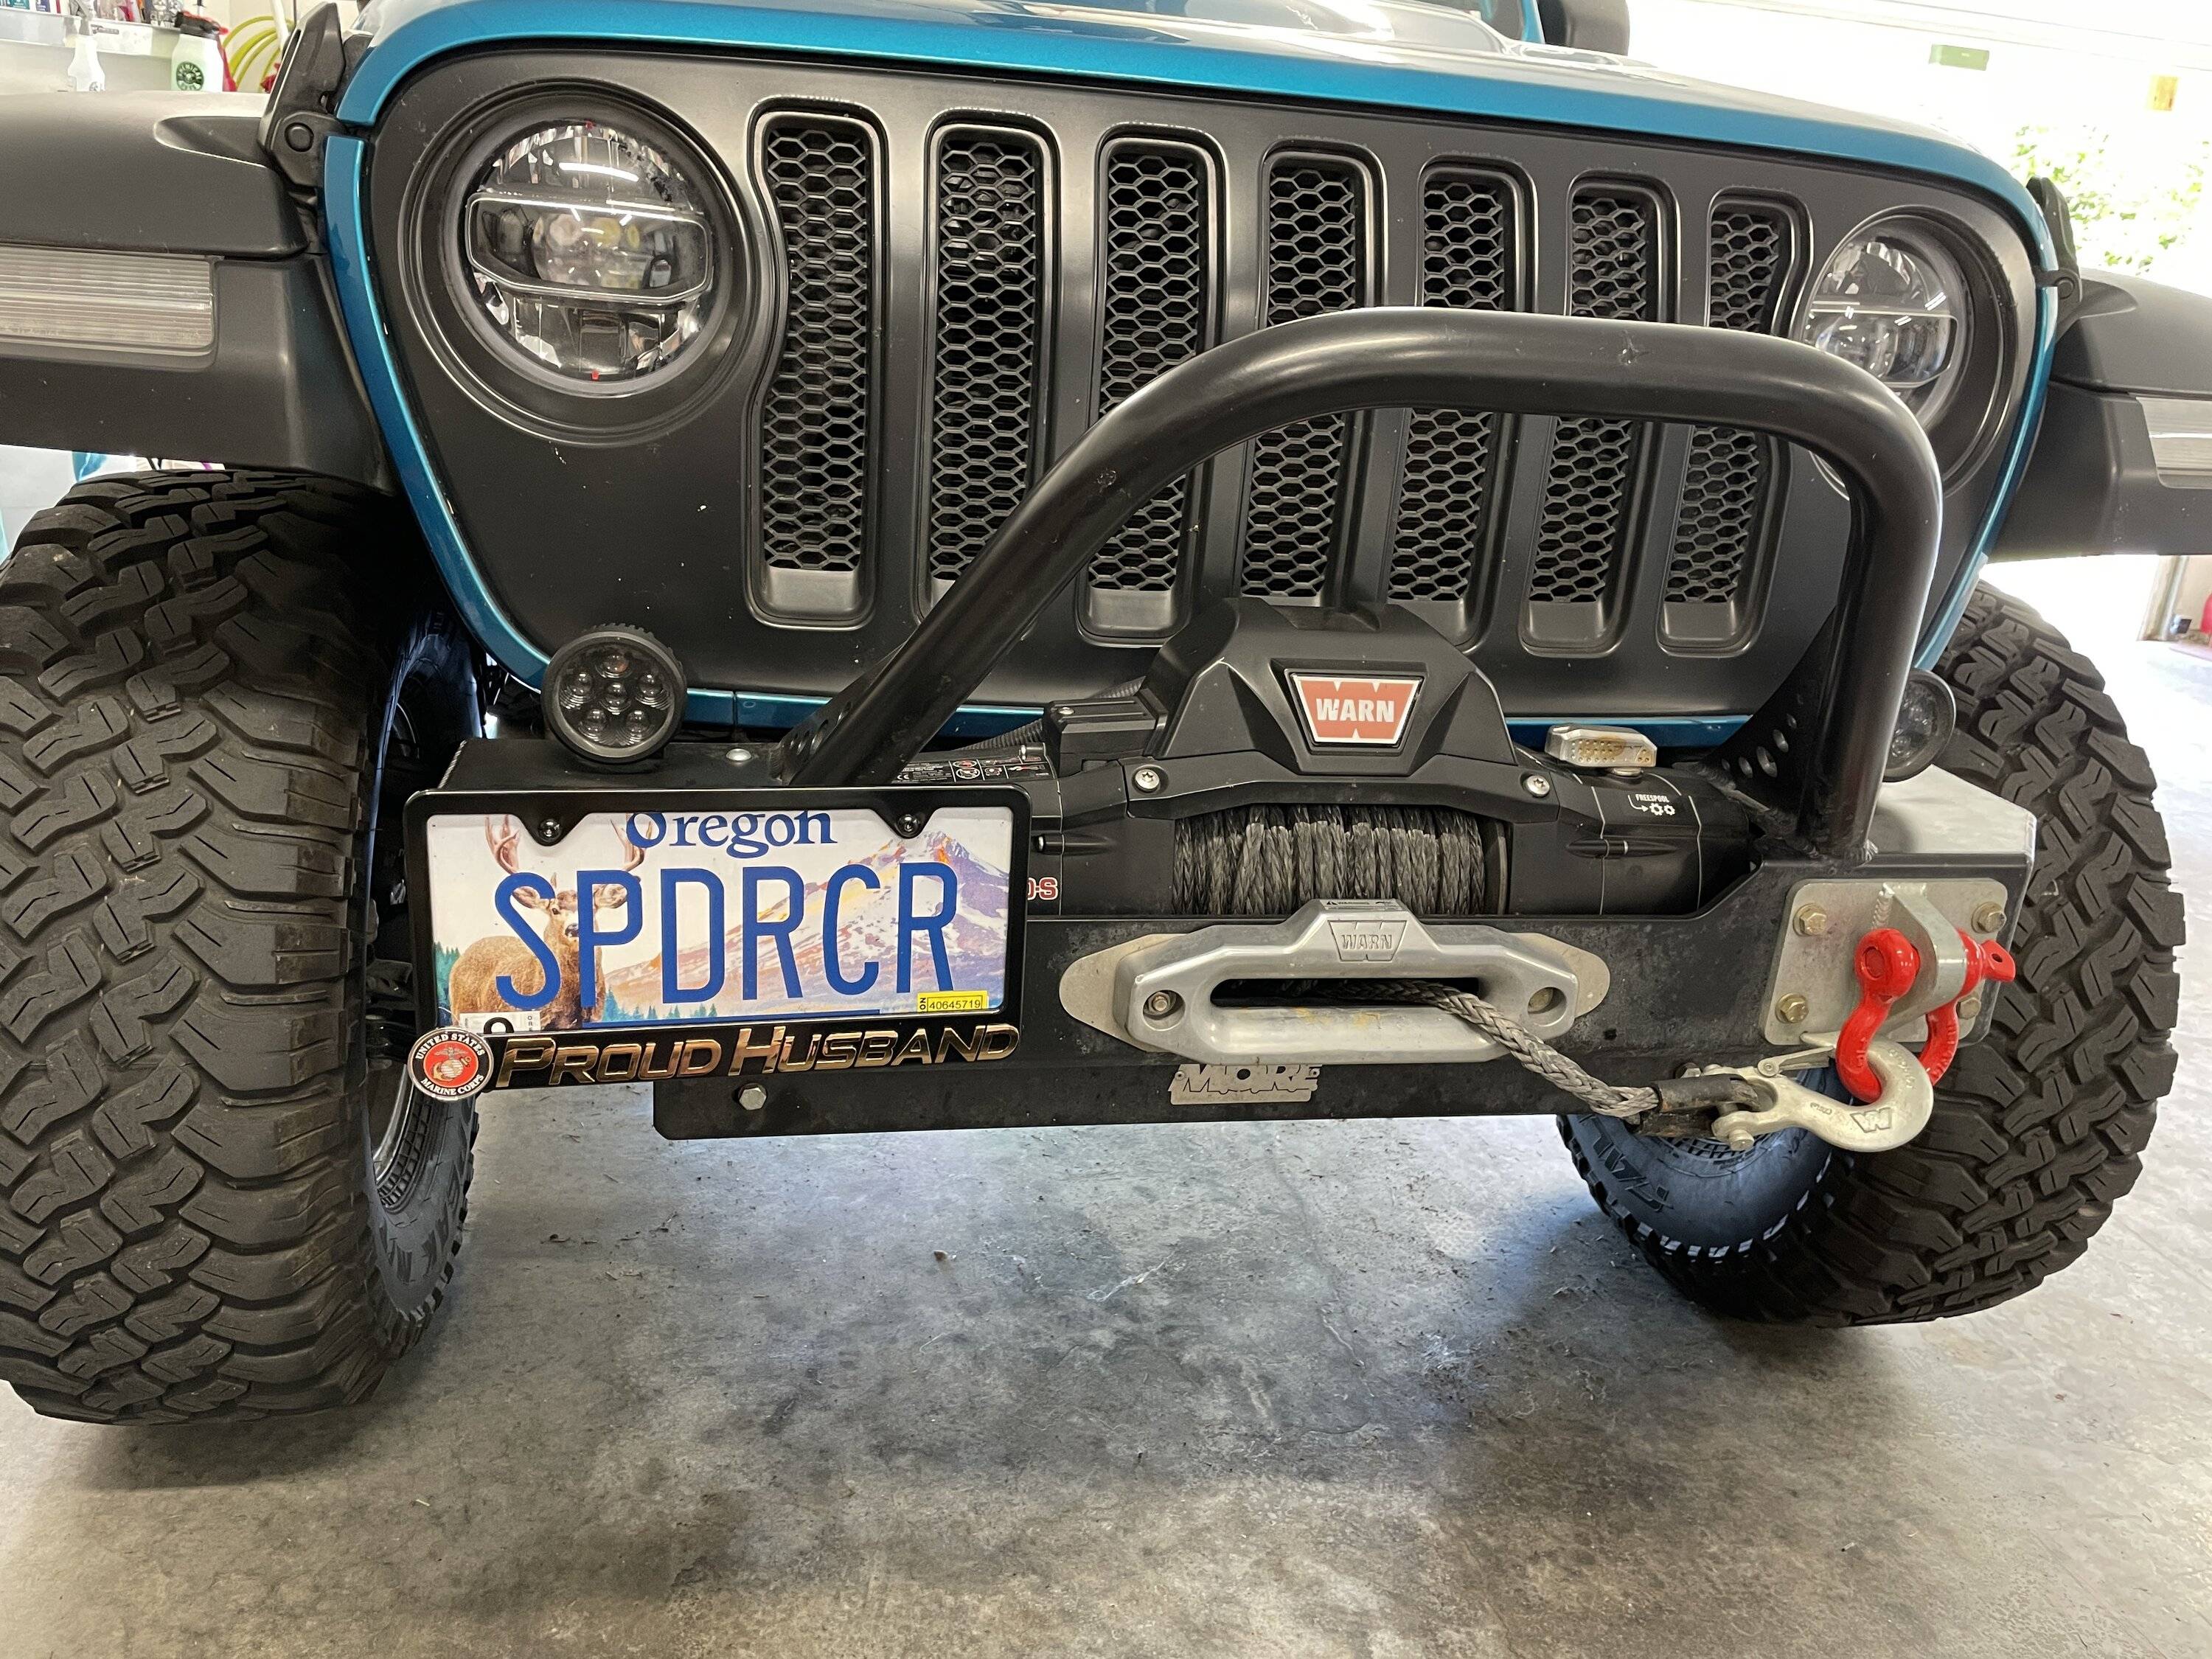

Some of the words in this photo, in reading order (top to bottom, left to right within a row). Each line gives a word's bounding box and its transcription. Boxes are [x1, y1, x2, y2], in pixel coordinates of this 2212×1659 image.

[1315, 698, 1395, 723] WARN
[626, 811, 838, 858] Oregon
[495, 862, 958, 1010] SPDRCR
[1341, 933, 1393, 950] WARN
[929, 1000, 981, 1010] 40645719
[414, 1034, 449, 1060] UNITED
[451, 1033, 485, 1056] STATES
[495, 1036, 723, 1088] PROUD
[728, 1023, 1019, 1077] HUSBAND
[420, 1078, 457, 1096] MARINE
[457, 1074, 484, 1093] CORPS
